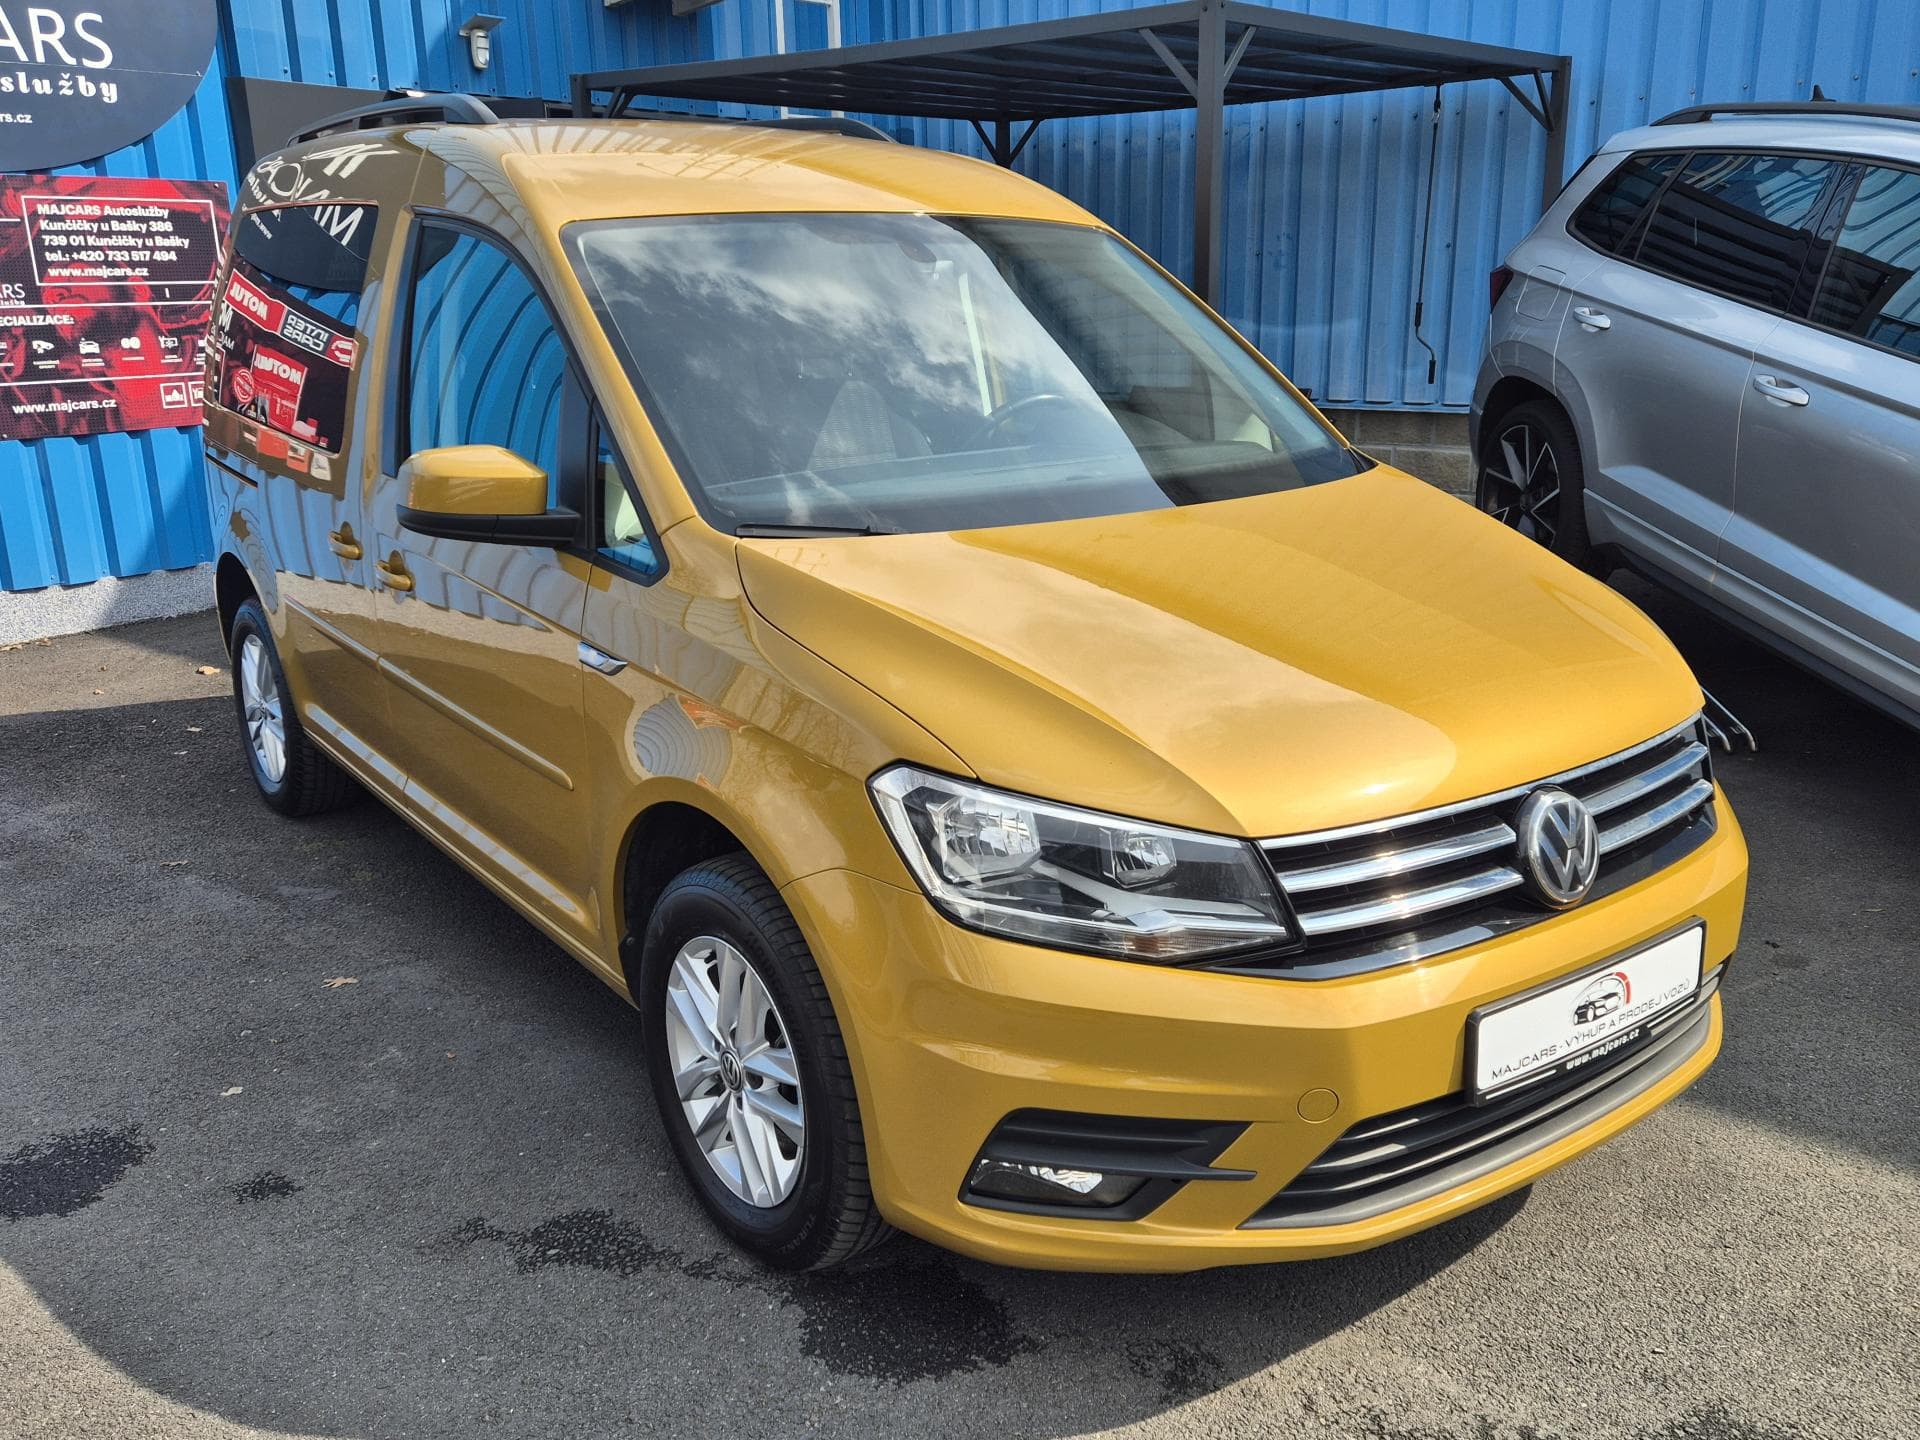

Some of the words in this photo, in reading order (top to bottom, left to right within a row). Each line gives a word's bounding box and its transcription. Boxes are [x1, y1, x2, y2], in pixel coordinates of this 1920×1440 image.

[0, 71, 118, 104] služby
[37, 203, 101, 216] MAJCARS
[103, 205, 169, 219] Autoslužby
[40, 219, 98, 233] Kunčičky
[100, 222, 109, 231] u
[111, 220, 147, 234] Bašky
[42, 234, 67, 246] 739
[69, 235, 85, 246] 01
[86, 234, 143, 249] Kunčičky
[145, 238, 154, 246] u
[154, 235, 190, 249] Bašky
[45, 250, 70, 262] tel.:
[72, 250, 105, 262] +420
[105, 250, 130, 262] 733
[131, 250, 151, 262] 517
[152, 250, 178, 262] 494
[47, 265, 150, 278] www.majcars.cz
[12, 399, 117, 414] www.majcars.cz
[1490, 1044, 1558, 1080] MAJCARS
[1608, 1019, 1616, 1032] A
[1618, 995, 1662, 1025] PRODEJ
